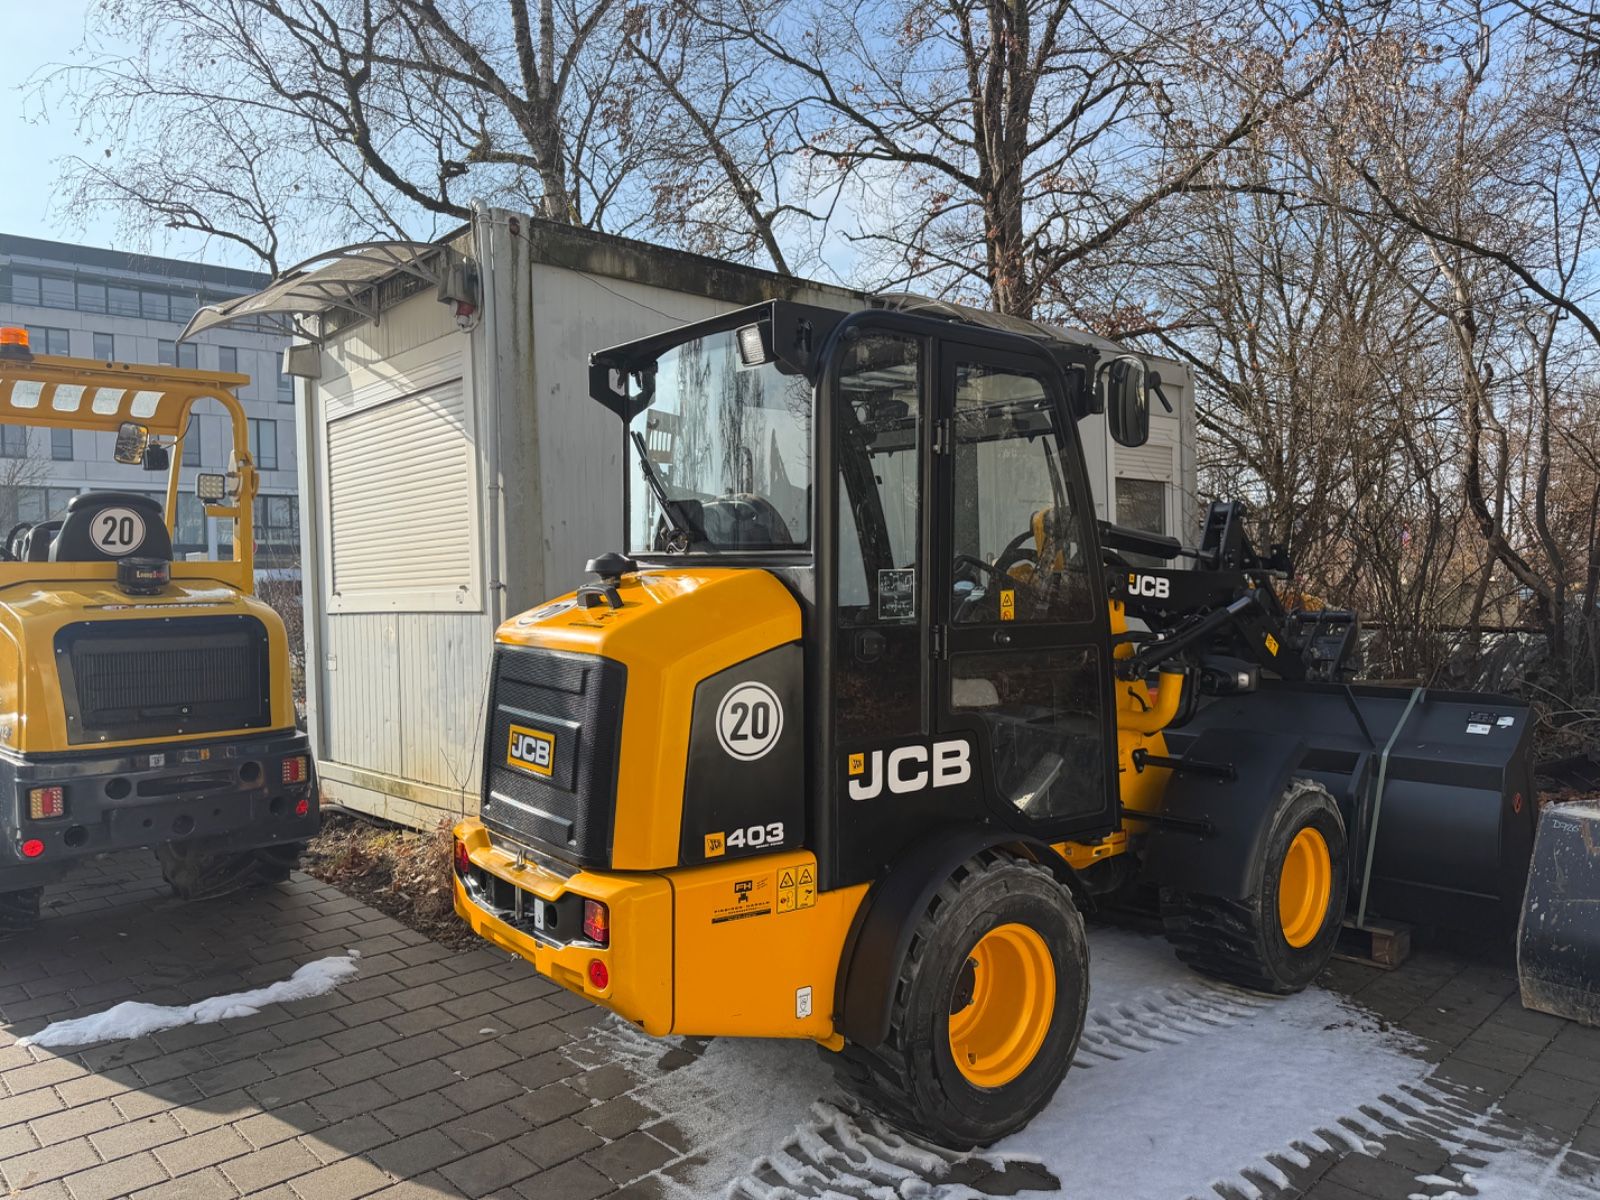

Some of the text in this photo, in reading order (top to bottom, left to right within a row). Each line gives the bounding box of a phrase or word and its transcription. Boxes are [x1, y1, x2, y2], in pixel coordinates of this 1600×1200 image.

[102, 516, 134, 546] 20
[1128, 574, 1170, 598] JCB
[730, 701, 771, 741] 20
[511, 733, 550, 766] JCB
[848, 739, 971, 801] JCB
[726, 822, 784, 848] 403
